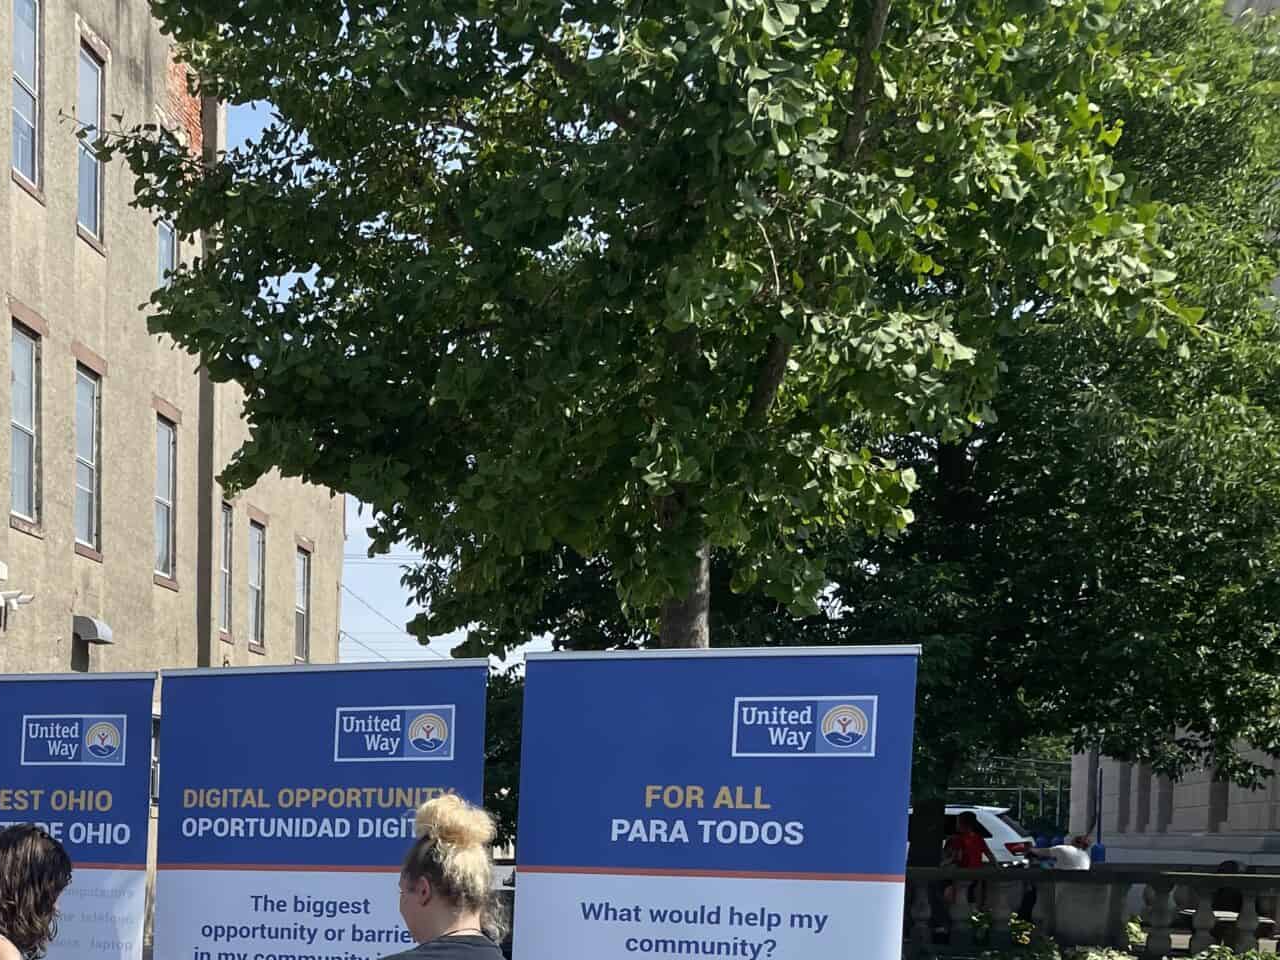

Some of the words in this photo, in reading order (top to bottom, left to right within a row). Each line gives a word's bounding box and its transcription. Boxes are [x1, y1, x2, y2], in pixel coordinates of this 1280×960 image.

[342, 715, 401, 733] United
[742, 705, 813, 726] United
[28, 722, 80, 739] United
[768, 727, 812, 751] Way
[47, 740, 79, 760] Way
[365, 733, 400, 755] Way
[50, 789, 113, 812] OHIO
[183, 788, 271, 809] DIGITAL
[277, 787, 455, 809] OPPORTUNI
[644, 784, 705, 810] FOR
[713, 785, 771, 810] ALL
[69, 823, 131, 846] OHIO
[182, 817, 352, 839] OPORTUNIDAD
[357, 817, 417, 839] DIGIT
[610, 819, 689, 844] PARA
[697, 820, 805, 846] TODOS
[250, 894, 287, 914] The
[292, 895, 370, 918] biggest
[580, 901, 642, 924] What
[649, 904, 722, 926] would
[728, 906, 782, 932] help
[789, 912, 829, 934] my
[201, 921, 317, 945] opportunity
[324, 925, 346, 942] or
